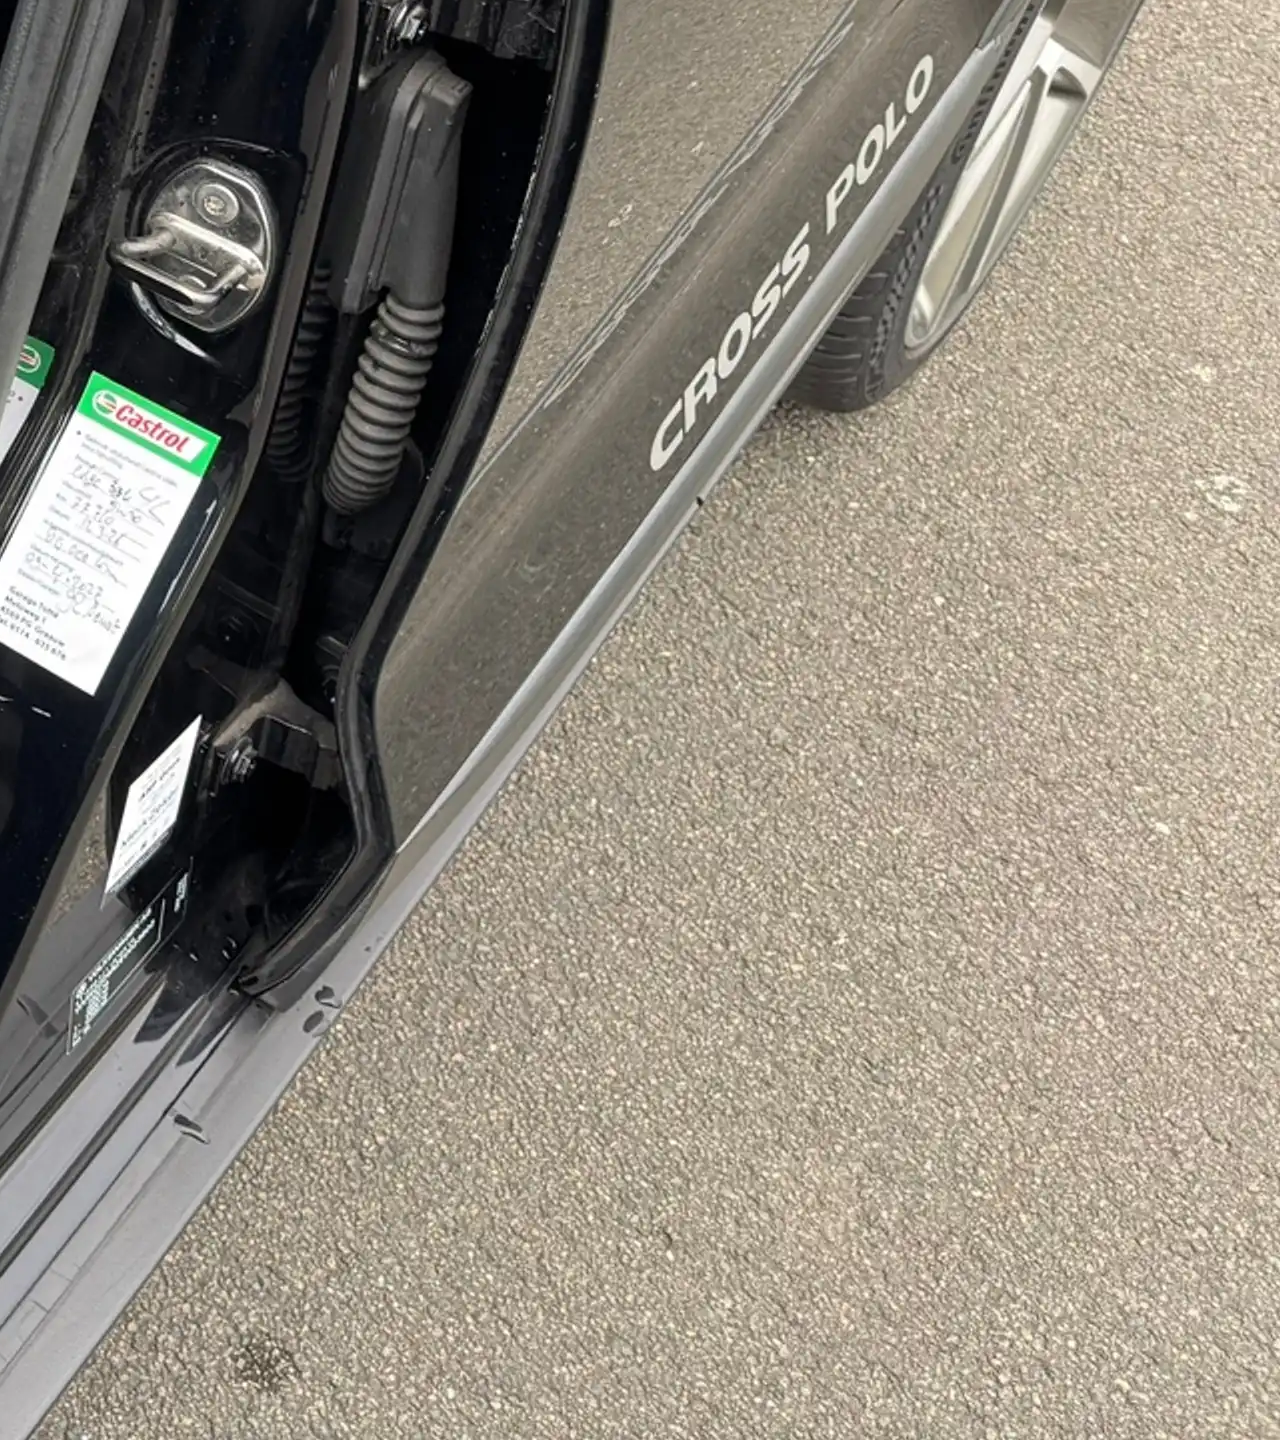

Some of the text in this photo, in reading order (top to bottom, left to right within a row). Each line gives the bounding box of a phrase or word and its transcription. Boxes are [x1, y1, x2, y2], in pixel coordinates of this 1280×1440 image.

[648, 54, 935, 472] CROSS POLO
[115, 404, 191, 453] Castrol
